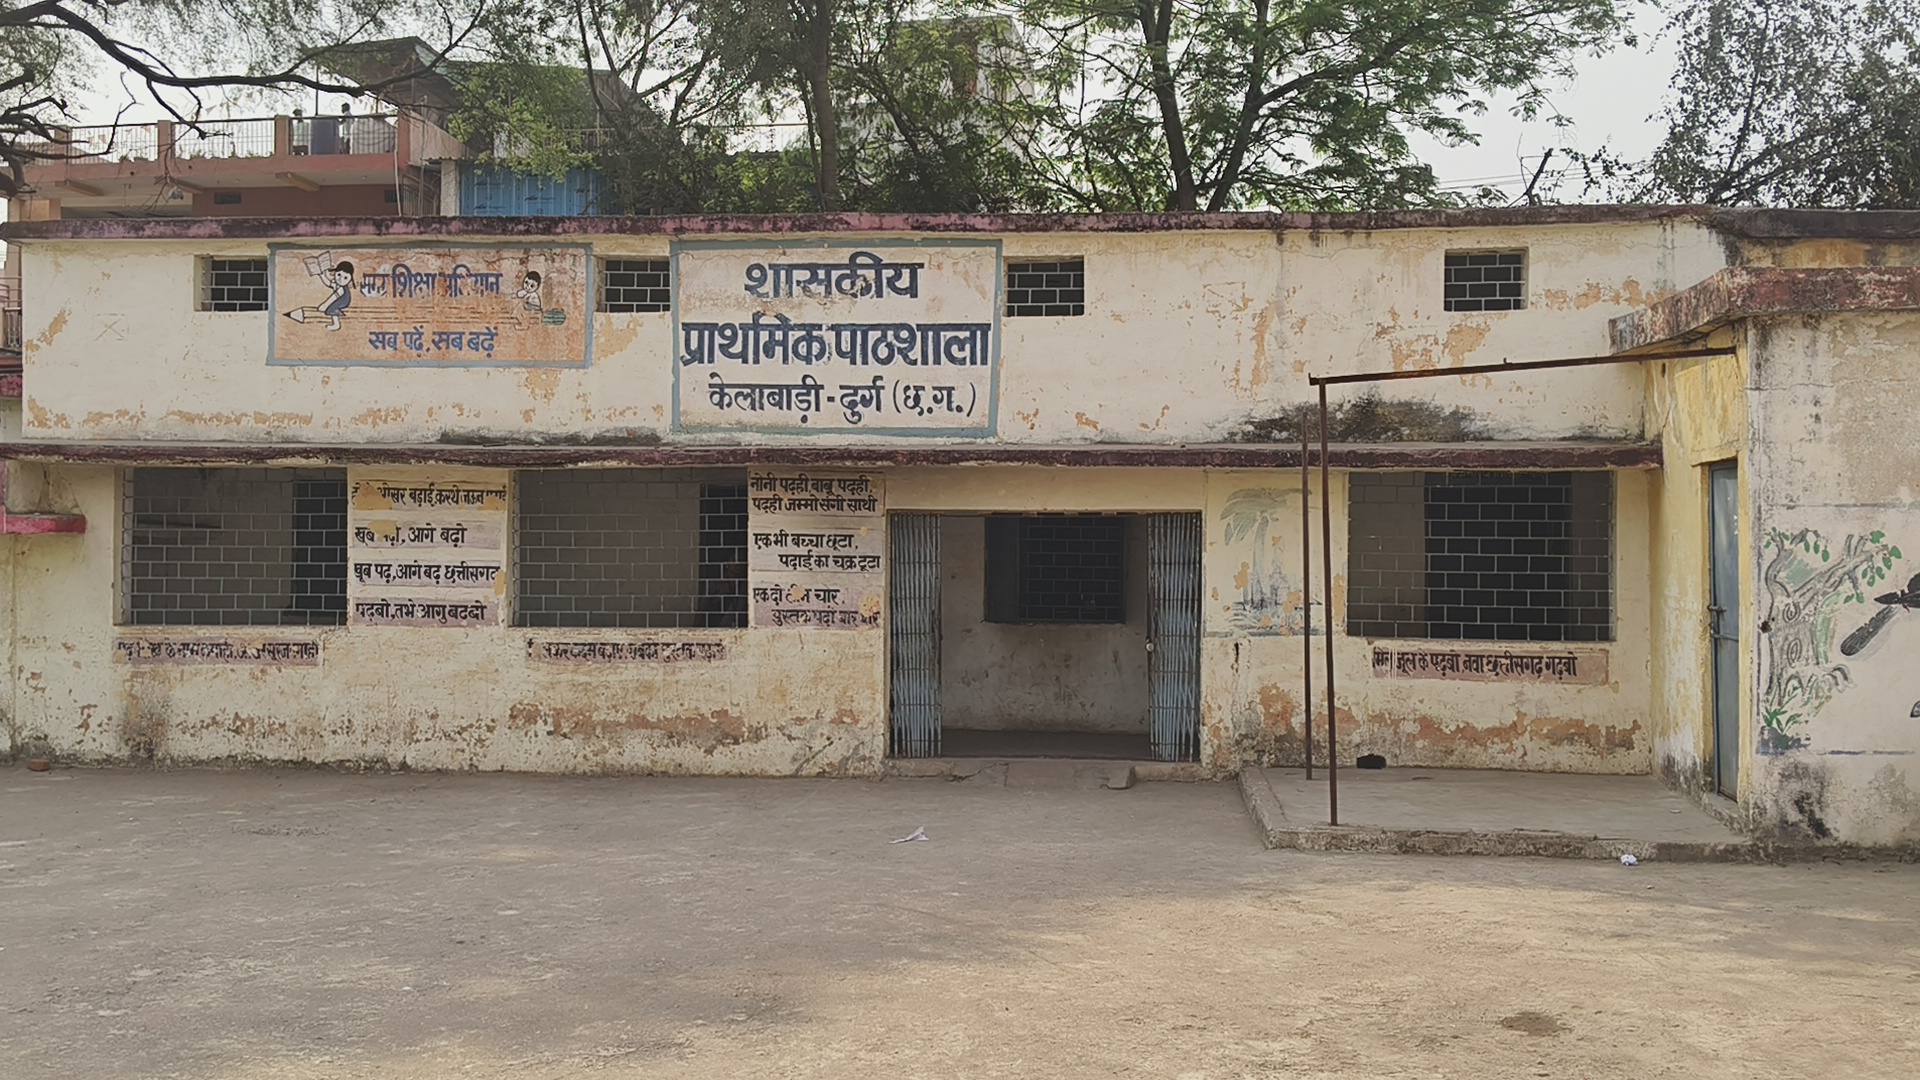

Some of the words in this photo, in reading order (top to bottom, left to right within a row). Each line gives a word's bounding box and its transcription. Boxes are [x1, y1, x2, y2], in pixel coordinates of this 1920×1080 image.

[744, 251, 925, 299] शासकीय
[369, 331, 399, 351] सब
[432, 331, 465, 351] सब
[467, 326, 499, 358] बढ़ें
[680, 312, 828, 366] प्राथमिक
[830, 322, 991, 366] पाठशाला
[811, 478, 836, 496] बाबू
[407, 523, 436, 543] आगे
[440, 523, 467, 548] बढ़ो
[790, 533, 825, 549] बच्चा
[396, 560, 423, 580] आगे
[423, 565, 442, 585] बढ़
[815, 556, 830, 569] का
[831, 555, 858, 571] चक्र
